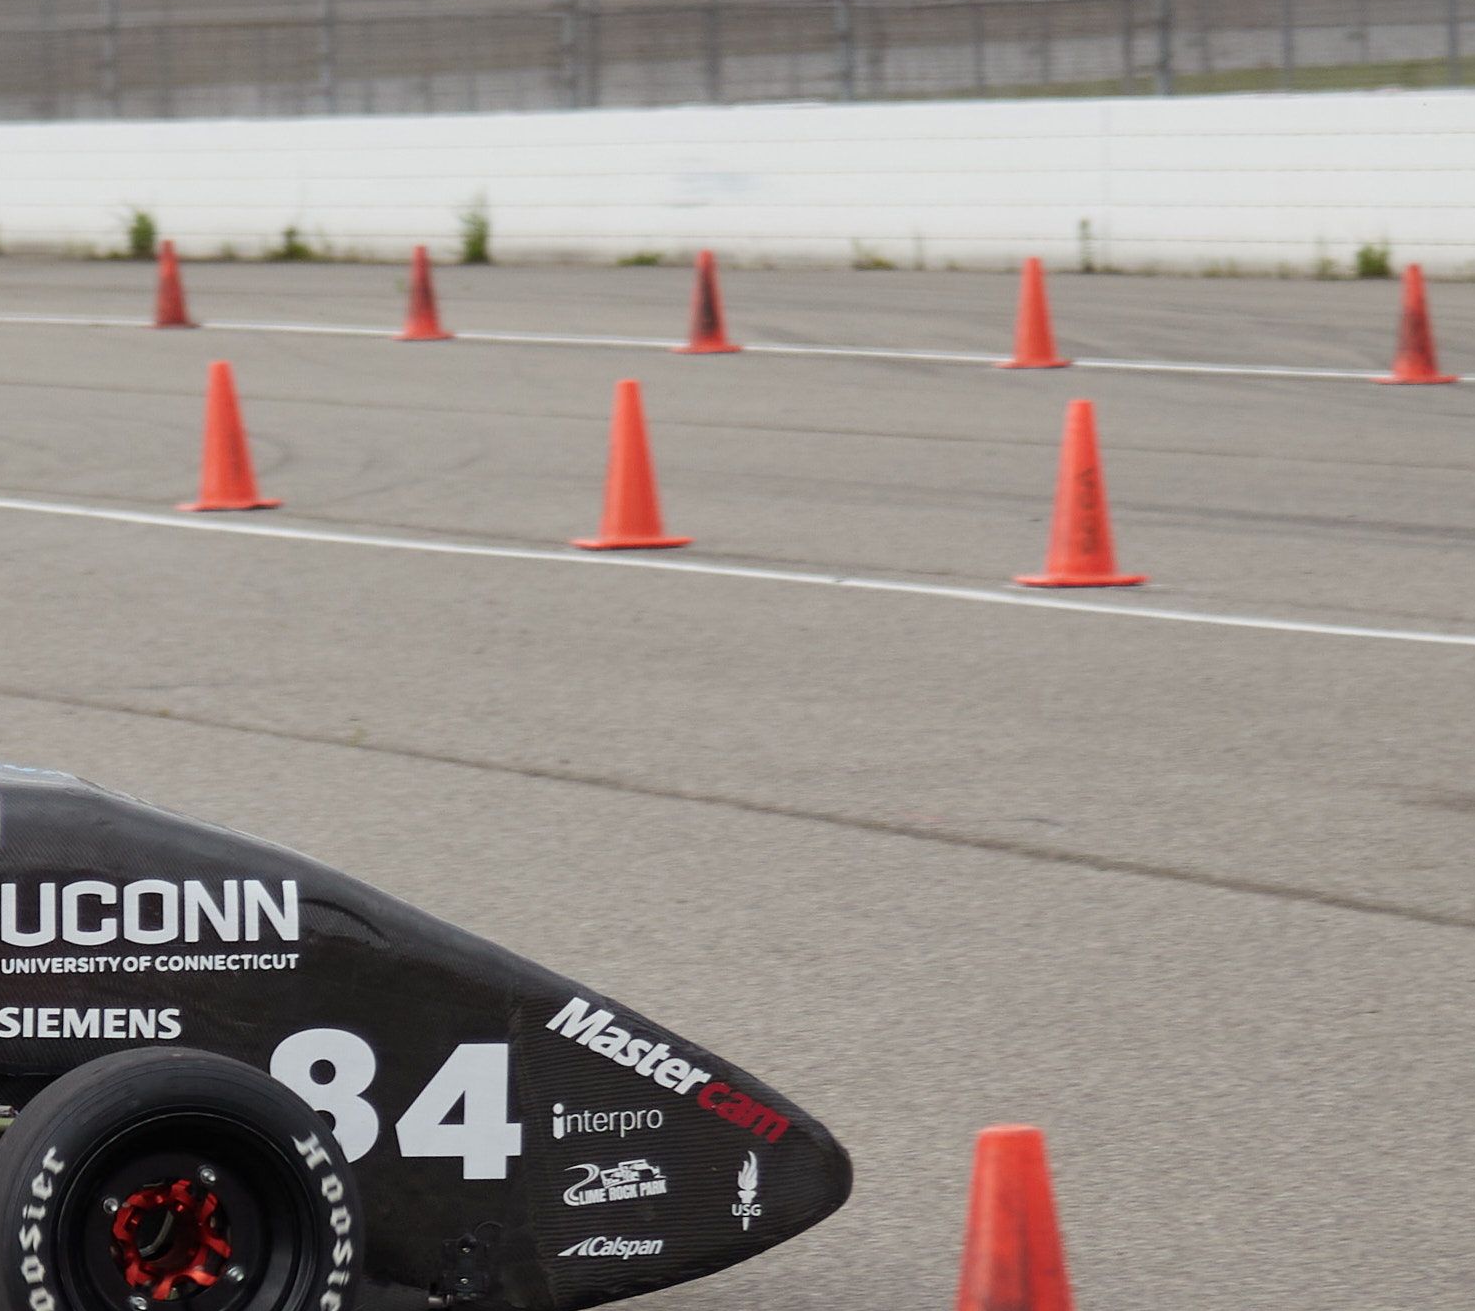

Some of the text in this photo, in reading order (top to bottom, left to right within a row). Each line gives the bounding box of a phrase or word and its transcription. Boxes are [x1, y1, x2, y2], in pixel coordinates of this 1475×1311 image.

[0, 878, 300, 947] UCONN
[1, 953, 300, 975] UNIVERSITY OF CONNECTICUT
[546, 995, 791, 1144] Mastercam
[269, 1027, 522, 1180] 84
[552, 1102, 663, 1139] interpro
[578, 1178, 668, 1206] LIME ROCK PARK
[731, 1202, 762, 1217] USG
[587, 1236, 664, 1260] Calspan
